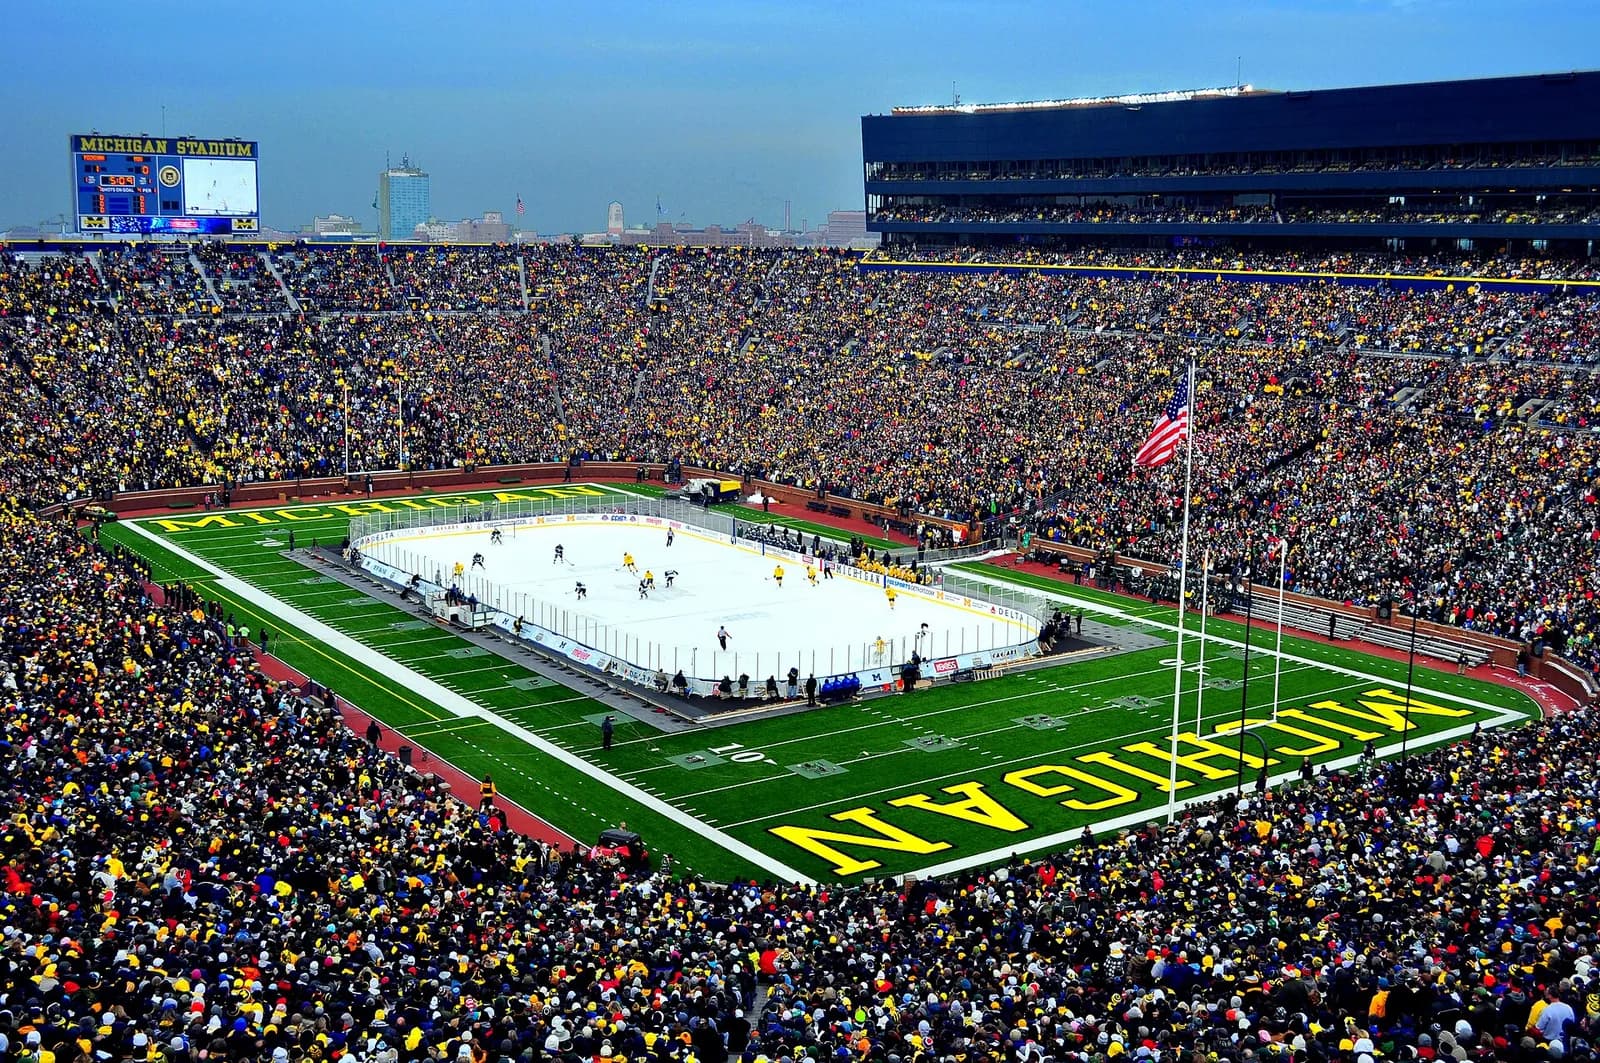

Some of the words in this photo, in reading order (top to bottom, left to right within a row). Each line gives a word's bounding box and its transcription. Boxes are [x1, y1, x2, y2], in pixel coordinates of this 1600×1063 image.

[80, 137, 168, 154] MICHIGAN
[176, 141, 252, 157] STADIUM
[109, 176, 134, 185] 5:09
[148, 486, 609, 533] MICHIGAN
[836, 564, 881, 584] MICHIGAN
[998, 607, 1024, 621] DELTA
[872, 673, 882, 682] M
[707, 742, 766, 763] 10
[768, 688, 1474, 877] MICHIGAN
